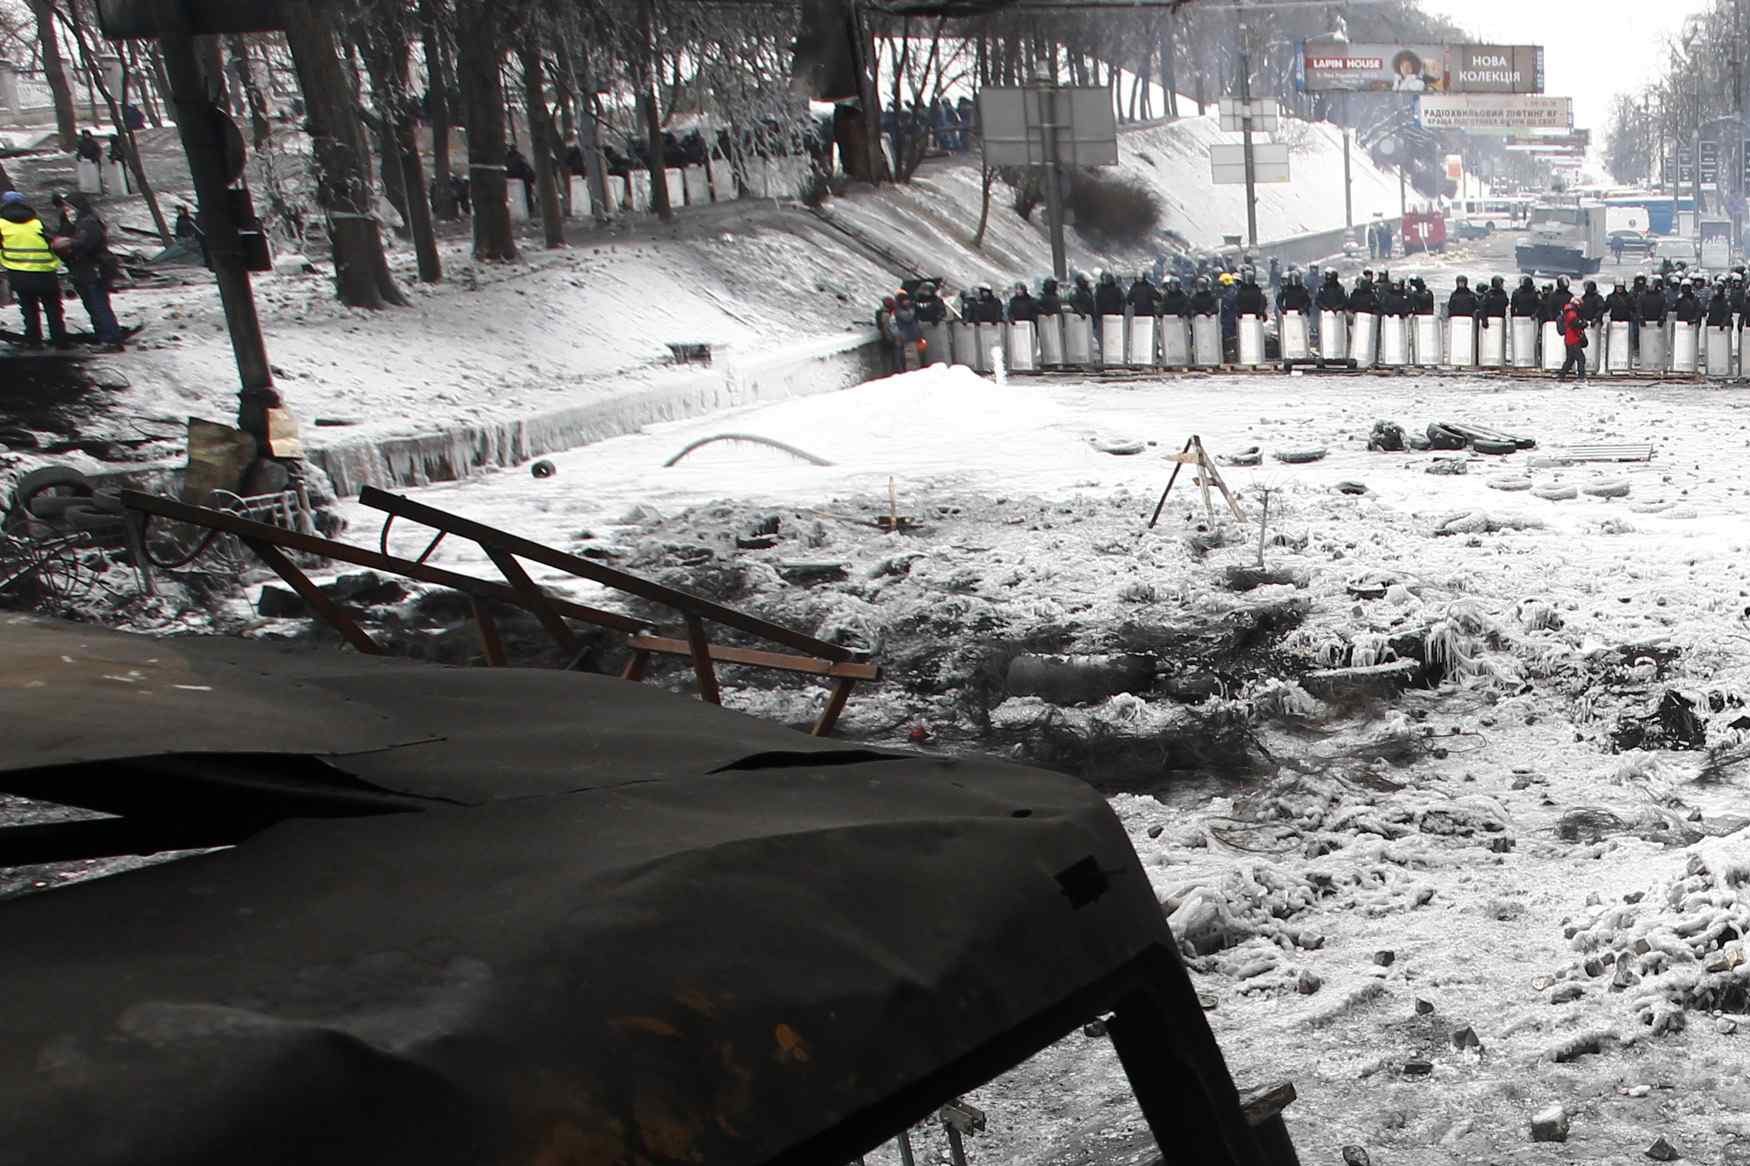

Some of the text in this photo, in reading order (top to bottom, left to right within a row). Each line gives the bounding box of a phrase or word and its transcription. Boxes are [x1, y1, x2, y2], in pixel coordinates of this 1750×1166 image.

[1313, 59, 1380, 68] LAPIN HOUSE
[1472, 55, 1507, 66] НОВА
[1459, 71, 1521, 84] КОЛЕКЦІЯ
